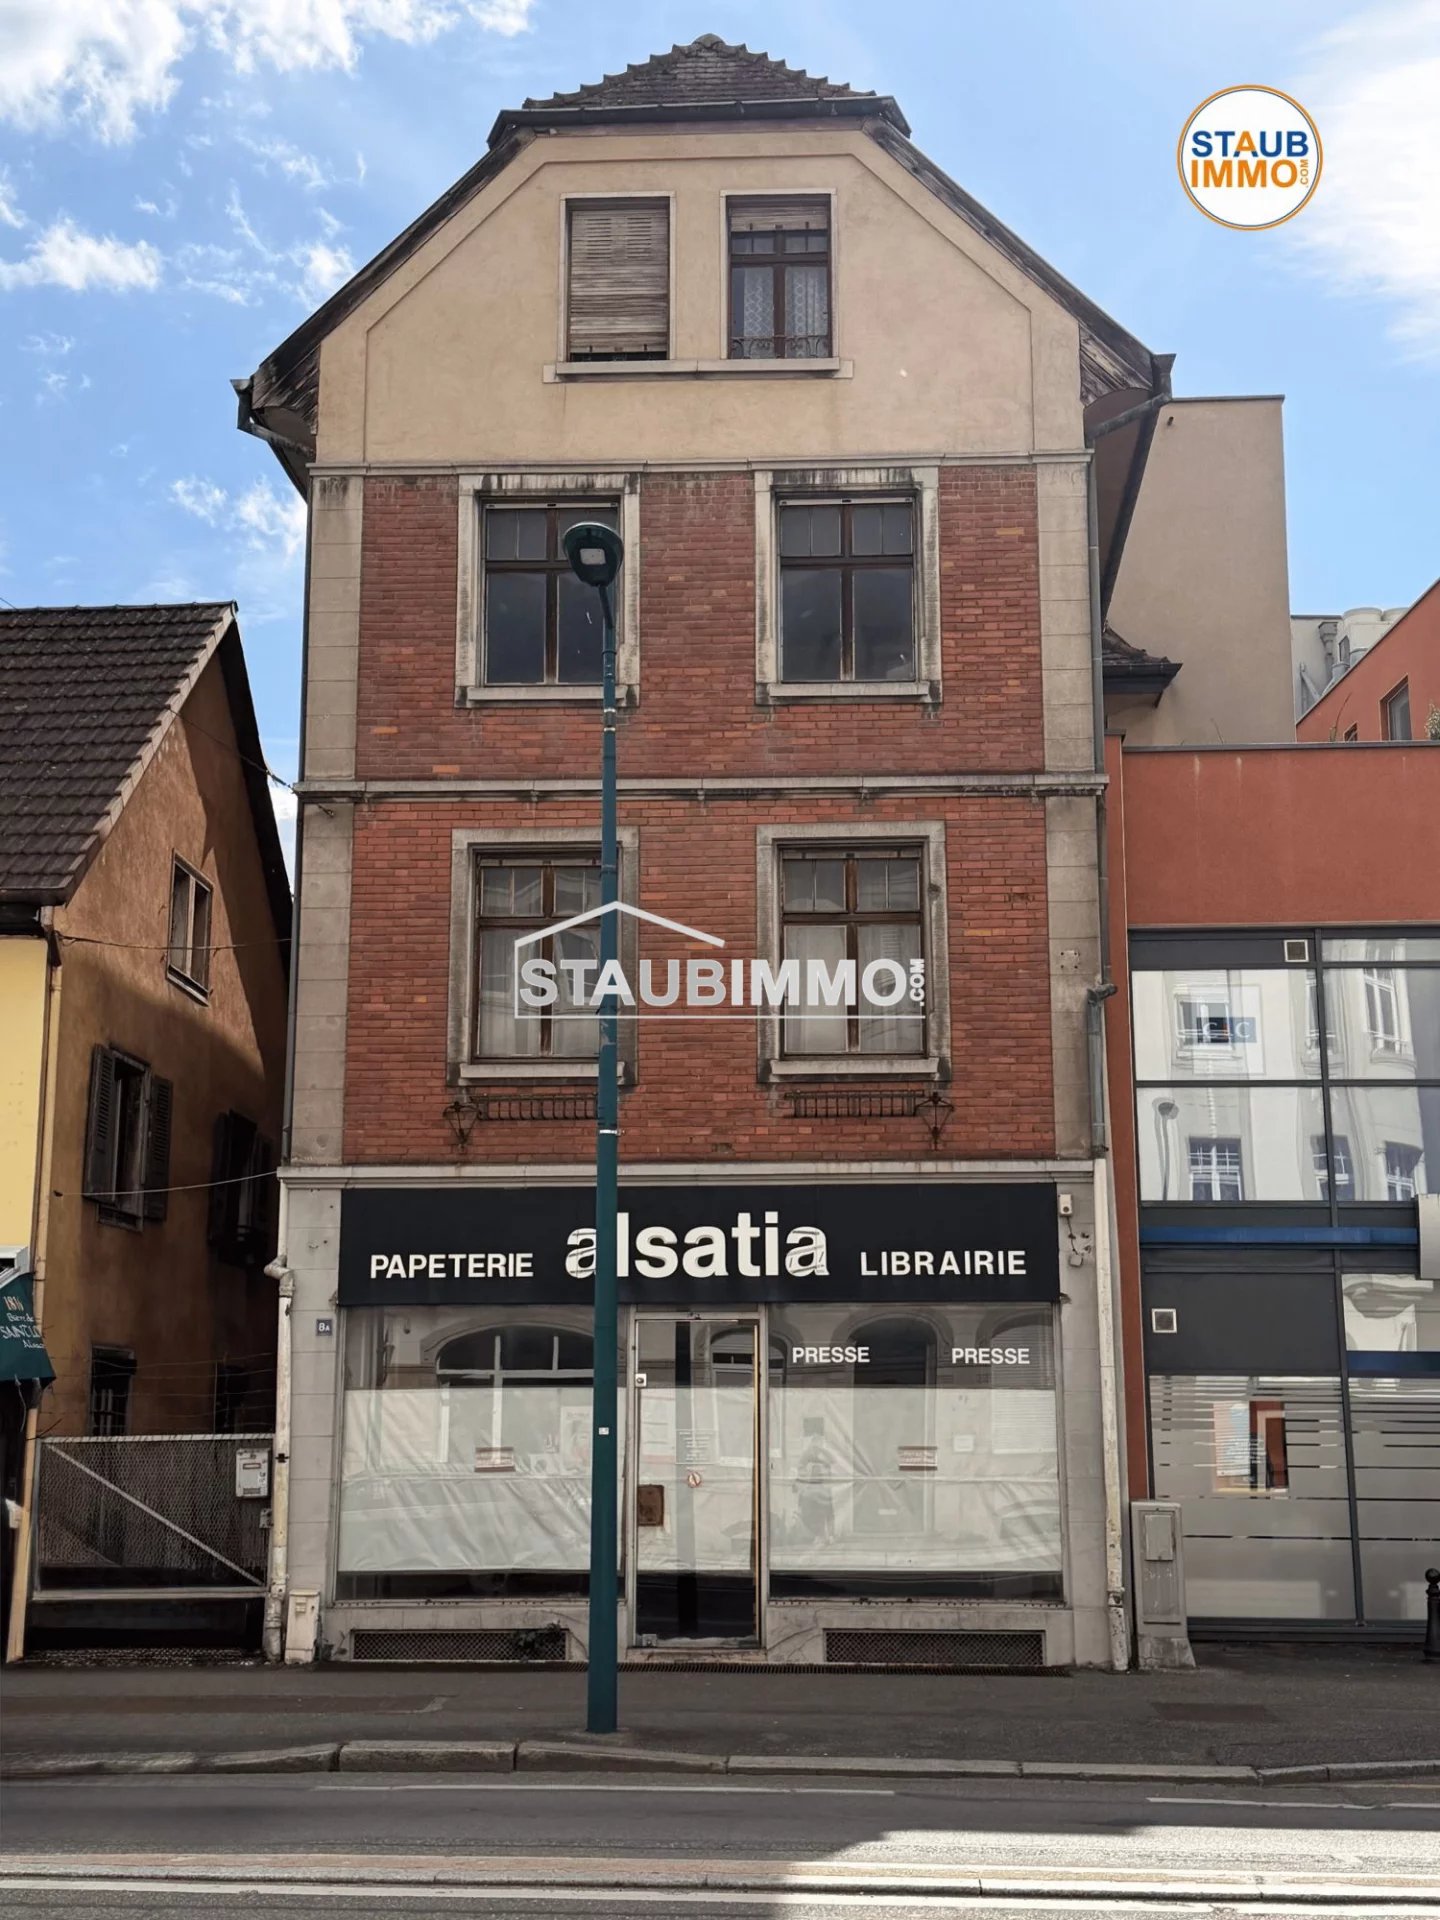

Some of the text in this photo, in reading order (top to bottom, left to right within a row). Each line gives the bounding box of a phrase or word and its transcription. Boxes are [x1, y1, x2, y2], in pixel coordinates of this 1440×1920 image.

[370, 1211, 1027, 1279] PAPETERIE alsatia LIBRAIRIE
[318, 1322, 331, 1332] 8A
[792, 1346, 870, 1363] PRESSE
[951, 1348, 1030, 1364] PRESSE
